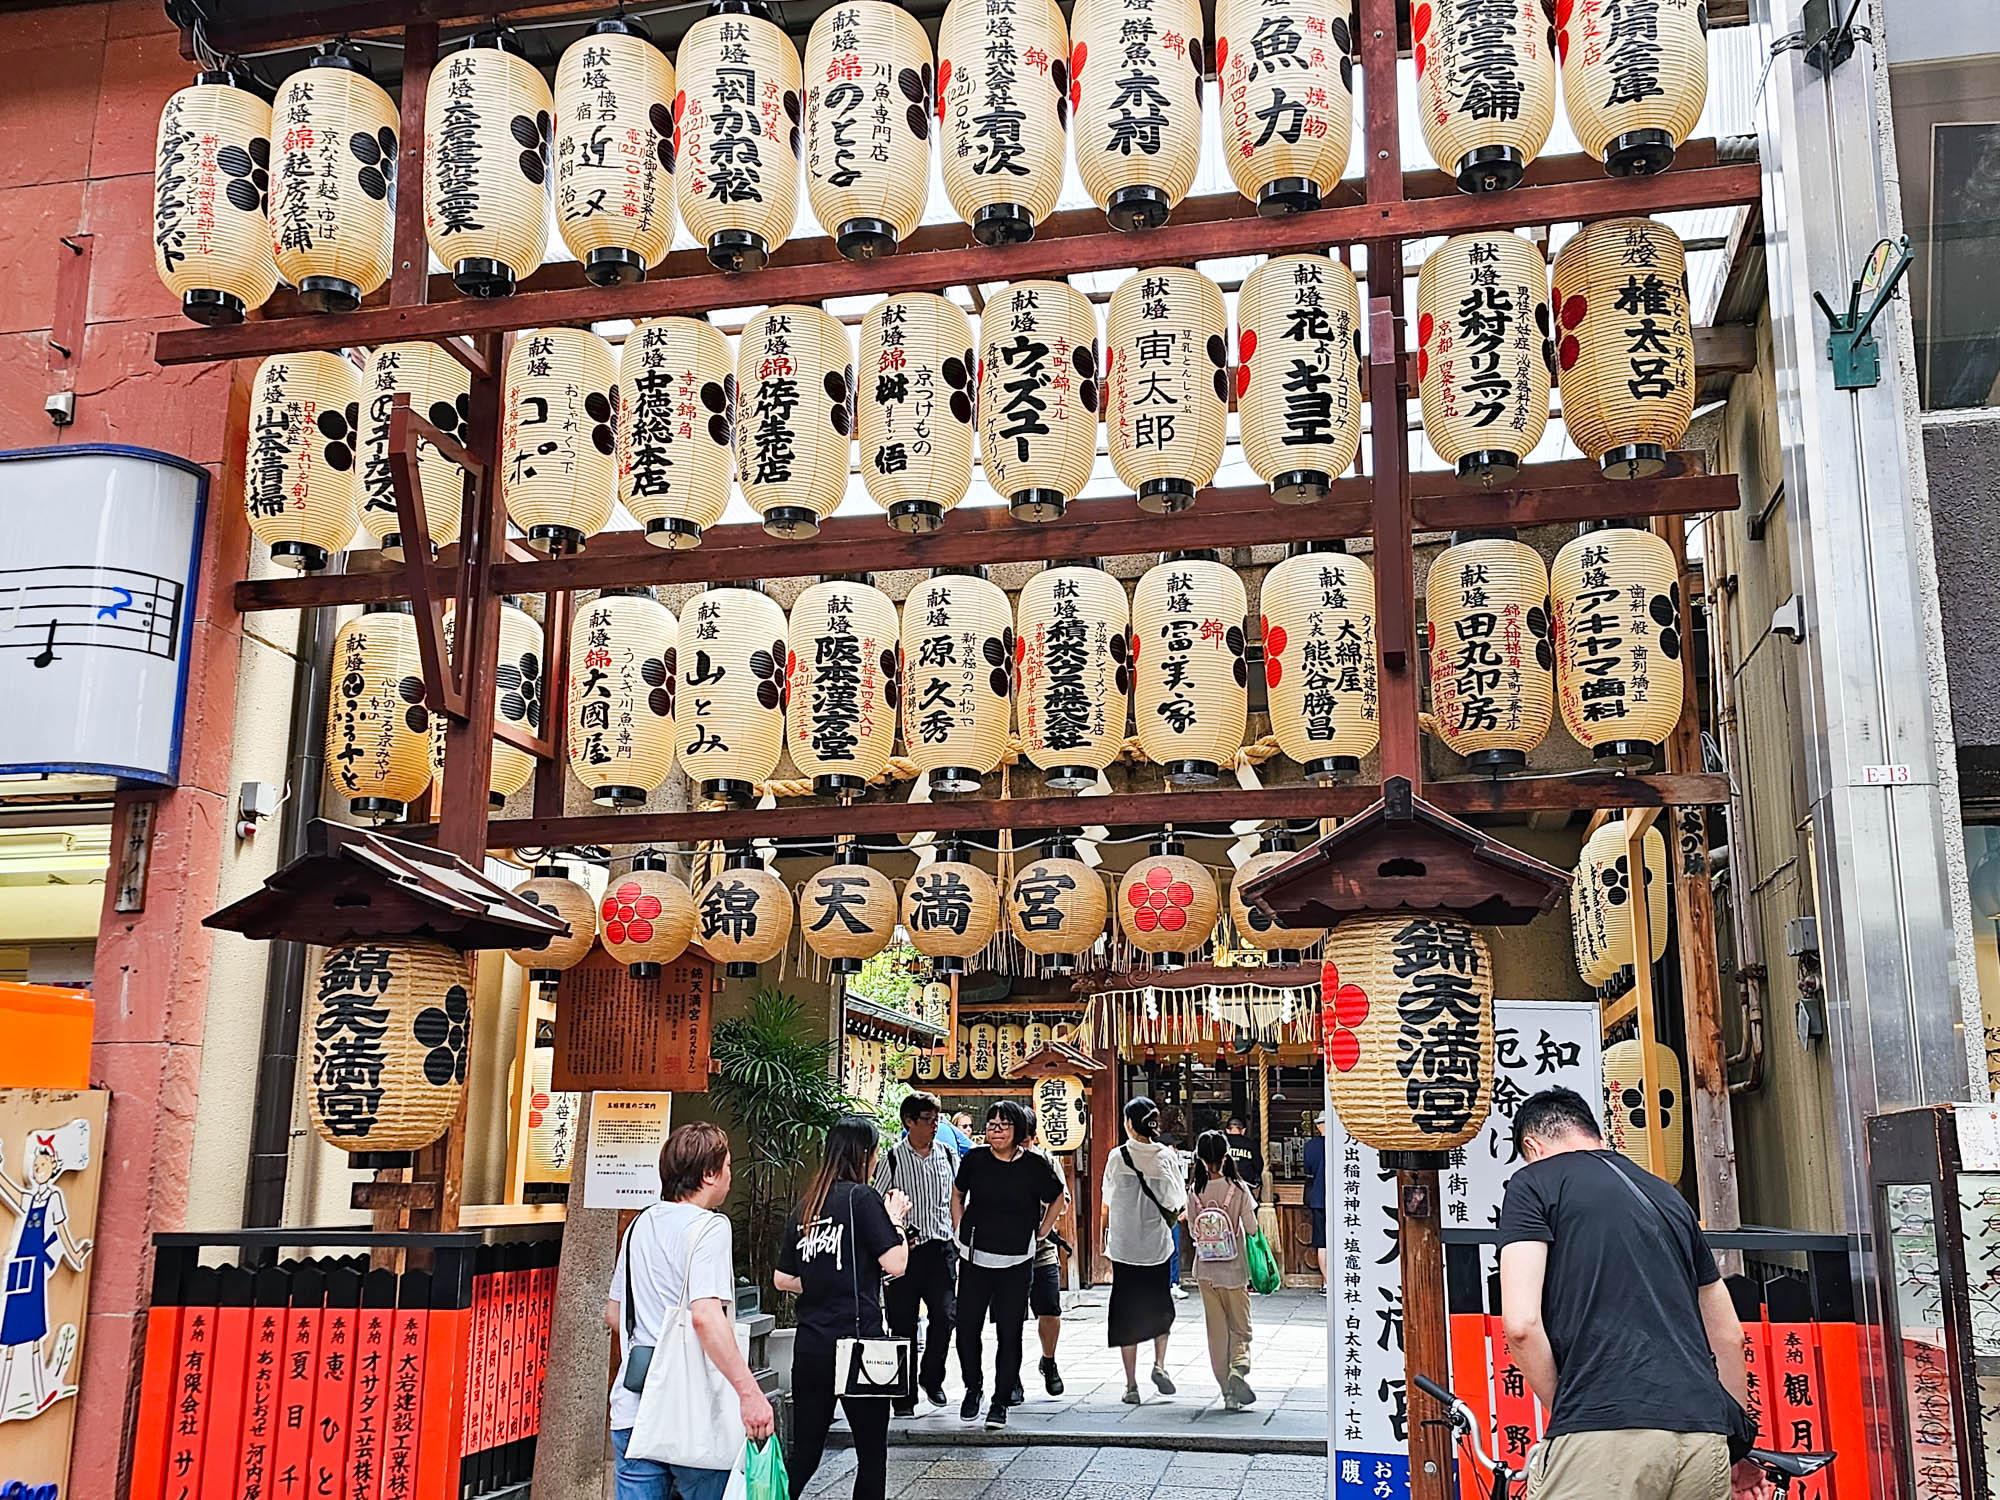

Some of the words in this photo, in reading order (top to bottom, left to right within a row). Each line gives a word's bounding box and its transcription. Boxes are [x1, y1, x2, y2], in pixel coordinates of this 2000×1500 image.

[720, 22, 751, 65] 献燈
[832, 9, 860, 52] 献燈
[1119, 17, 1157, 68] 鮮魚
[1160, 29, 1186, 61] 錦
[448, 58, 477, 99] 献燈
[582, 47, 611, 90] 献燈
[826, 54, 863, 82] 錦
[984, 39, 1018, 107] 株式会社
[1022, 46, 1049, 77] 錦
[1248, 15, 1310, 147] 魚力
[288, 82, 314, 124] 献燈
[575, 102, 593, 122] 宿
[597, 91, 619, 122] 懐石
[761, 78, 781, 144] 京野菜
[869, 63, 893, 162] 川魚専門店
[1105, 68, 1171, 156] 木村
[283, 125, 315, 154] 錦
[707, 104, 763, 204] かね松
[824, 83, 864, 187] のとよ
[972, 106, 1031, 176] 有次
[576, 125, 624, 217] 近又
[1469, 243, 1500, 287] 献燈
[1621, 226, 1662, 268] 献燈
[1141, 277, 1170, 320] 献燈
[1294, 264, 1324, 308] 献燈
[881, 305, 907, 347] 献燈
[1010, 290, 1039, 332] 献燈
[527, 337, 554, 377] 献燈
[641, 328, 668, 368] 献燈
[764, 316, 791, 355] 献燈
[1458, 287, 1513, 428] 北村クリニック
[1614, 273, 1675, 400] 権太呂
[375, 352, 401, 391] 献燈
[877, 347, 907, 373] 錦
[1050, 336, 1071, 420] 寺町錦上ル
[1181, 329, 1193, 414] 豆乳とんしゃぶ
[263, 364, 289, 404] 献燈
[676, 369, 697, 439] 寺町錦角
[999, 335, 1050, 462] ウィズユー
[1133, 329, 1178, 451] 寅太郎
[285, 401, 302, 446] 株式会社
[560, 383, 579, 474] おしゃれくつ下
[631, 369, 674, 497] 中徳総本店
[752, 378, 800, 485] 佐竹生花店
[912, 365, 934, 457] 京つけもの
[250, 406, 291, 518] 山本清掃
[1319, 566, 1349, 609] 献燈
[1460, 564, 1490, 608] 献燈
[1581, 545, 1610, 588] 献燈
[827, 595, 853, 634] 献燈
[926, 588, 952, 628] 献燈
[1052, 579, 1080, 619] 献燈
[1167, 572, 1194, 612] 献燈
[588, 608, 612, 648] 献燈
[696, 601, 721, 639] 献燈
[1200, 618, 1225, 650] 錦
[1307, 611, 1326, 637] 代表
[1501, 603, 1522, 669] 錦天神様角
[344, 633, 368, 672] 献燈
[583, 647, 612, 669] 錦
[1334, 618, 1364, 693] 大綿屋
[1455, 613, 1503, 731] 田丸印房
[1575, 589, 1629, 722] アキヤマ歯科
[616, 648, 638, 759] うなぎ川魚専門
[686, 650, 729, 755] 山とみ
[812, 635, 862, 762] 阪本漢方堂
[919, 634, 957, 744] 源久秀
[1043, 619, 1092, 750] 積水ハウス株式会社
[1302, 639, 1339, 741] 熊谷勝昌
[580, 668, 612, 766] 大國屋
[1866, 766, 1908, 783] E-13
[313, 946, 393, 1137] 錦天満宮
[1391, 920, 1482, 1134] 錦天満宮
[1535, 1028, 1581, 1076] 知
[1039, 1079, 1067, 1146] 錦天満宮
[1783, 1331, 1804, 1364] 奉納
[177, 1350, 206, 1436] 有限会社
[1783, 1372, 1814, 1452] 観月
[1341, 1458, 1364, 1485] 腹
